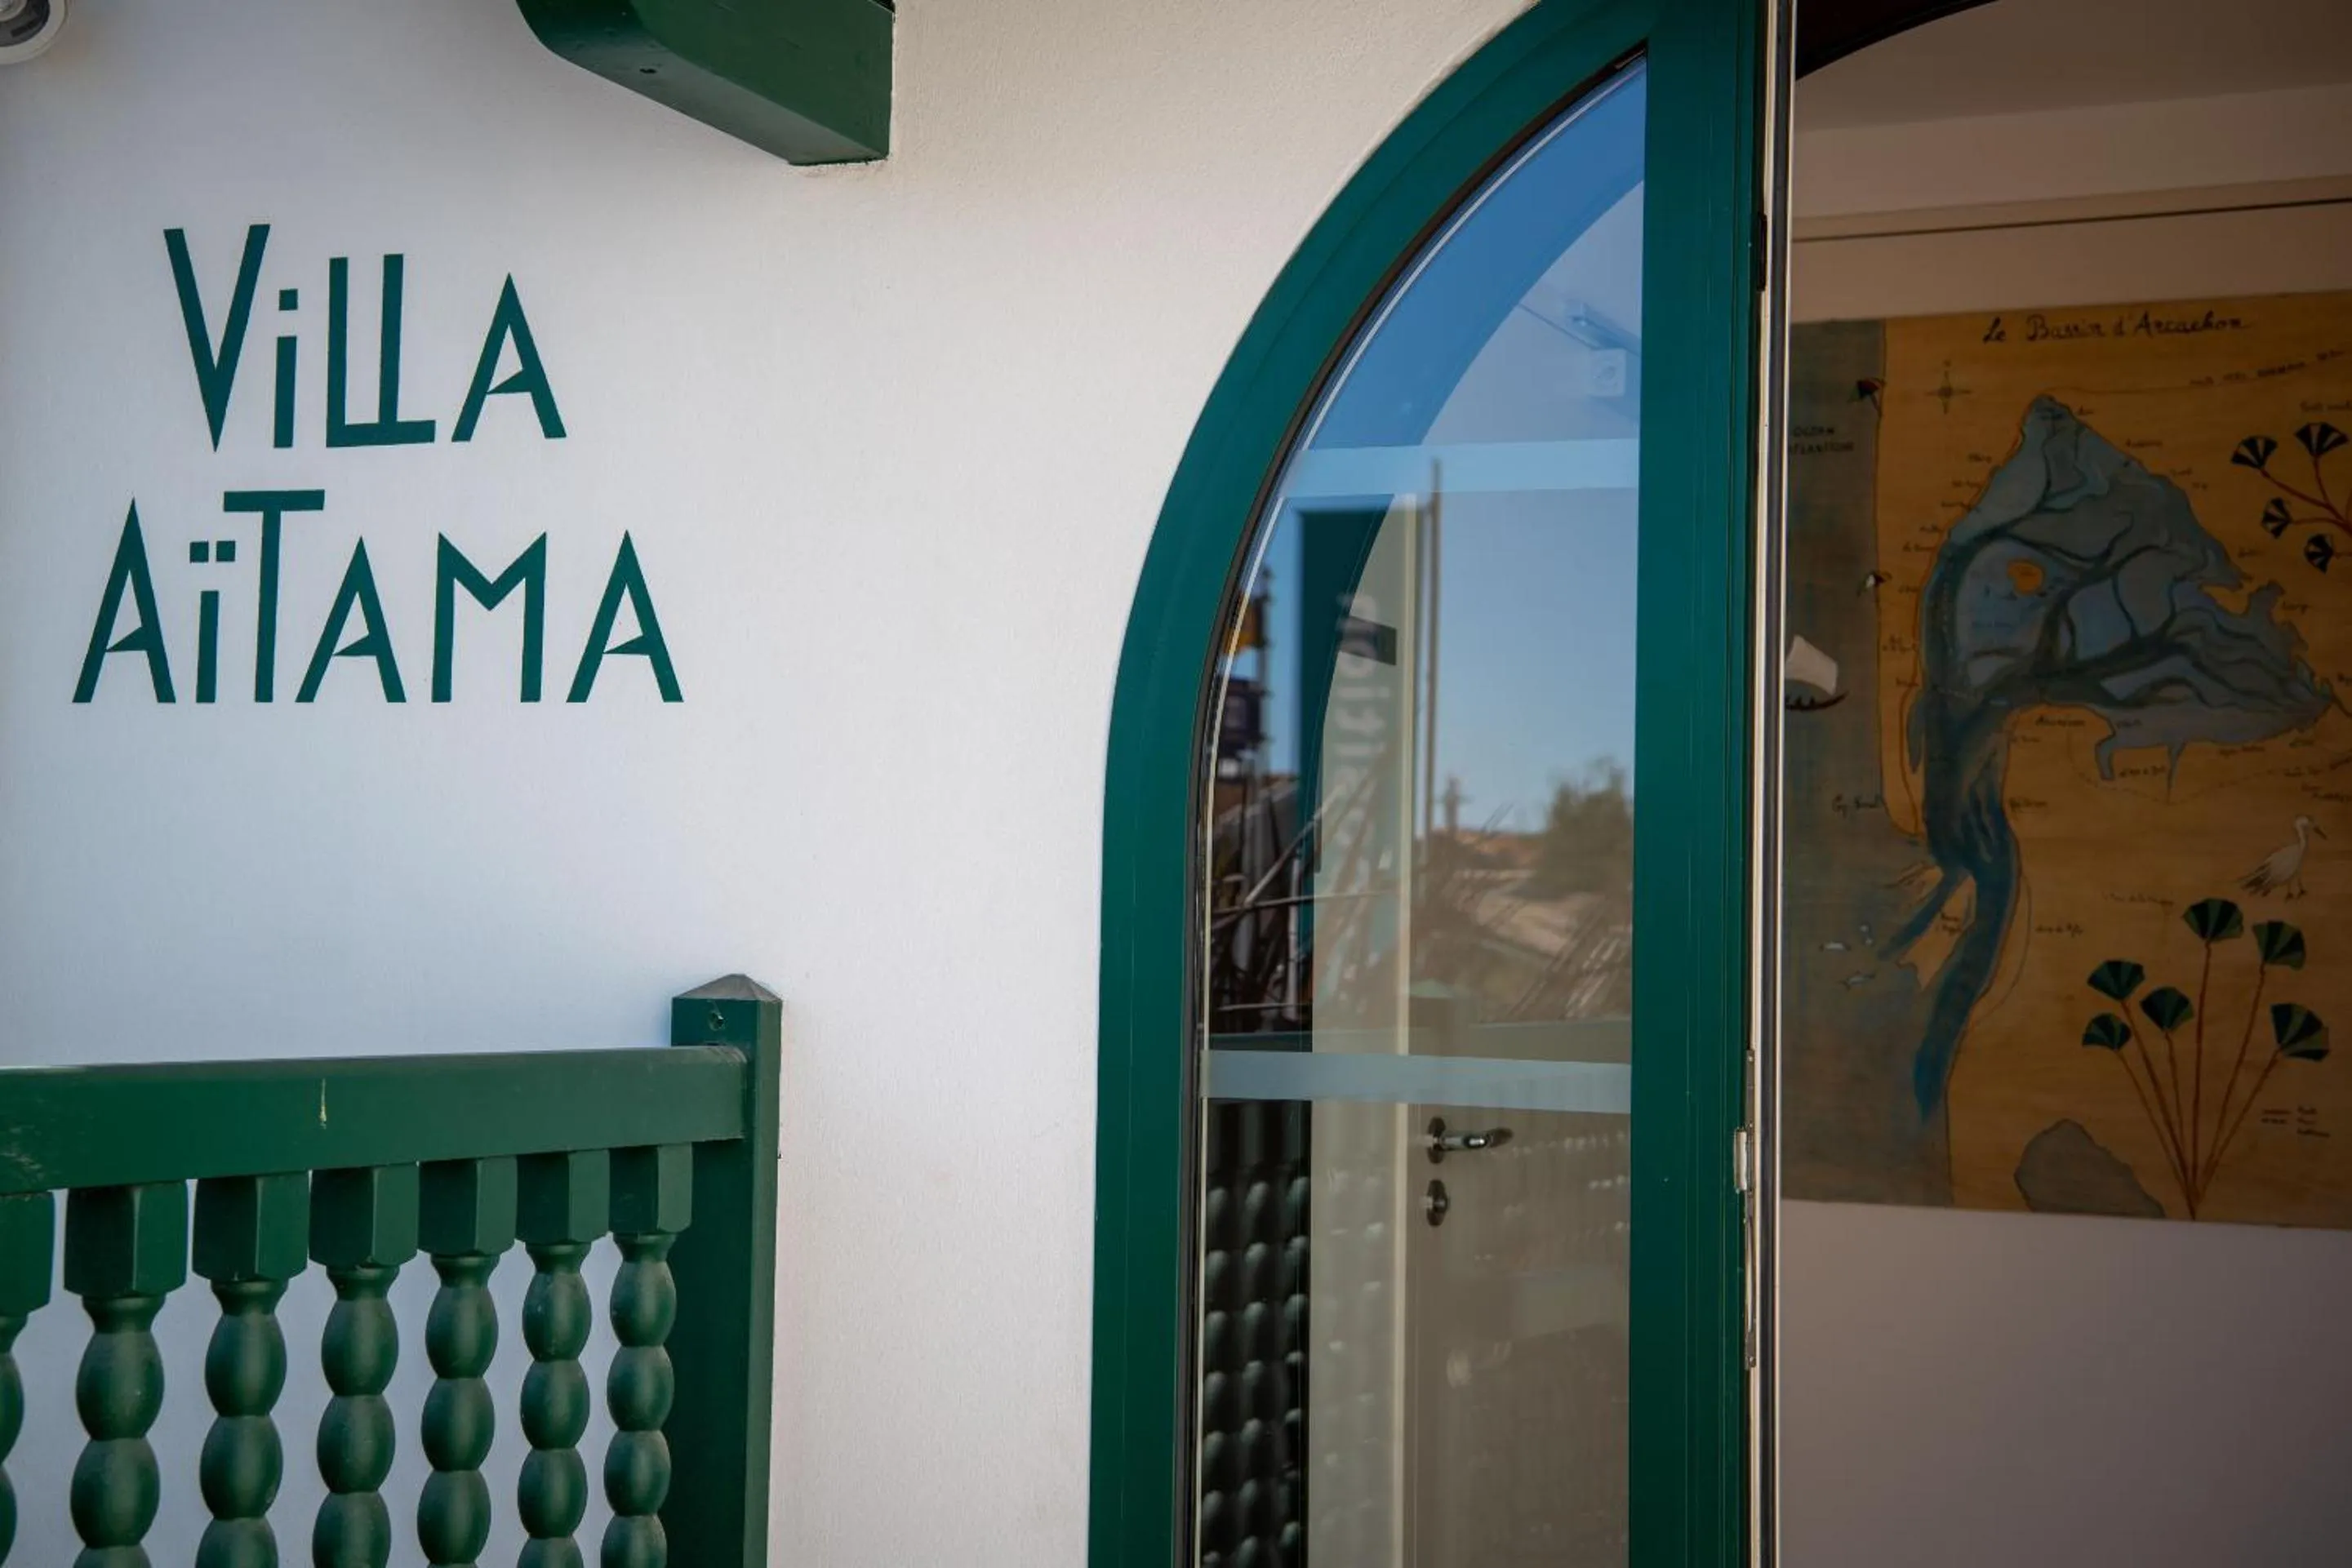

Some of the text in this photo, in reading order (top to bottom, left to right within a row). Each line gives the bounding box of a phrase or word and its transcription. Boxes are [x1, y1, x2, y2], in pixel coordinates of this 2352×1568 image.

[1983, 309, 2255, 343] Le Bassin d'Arcachon
